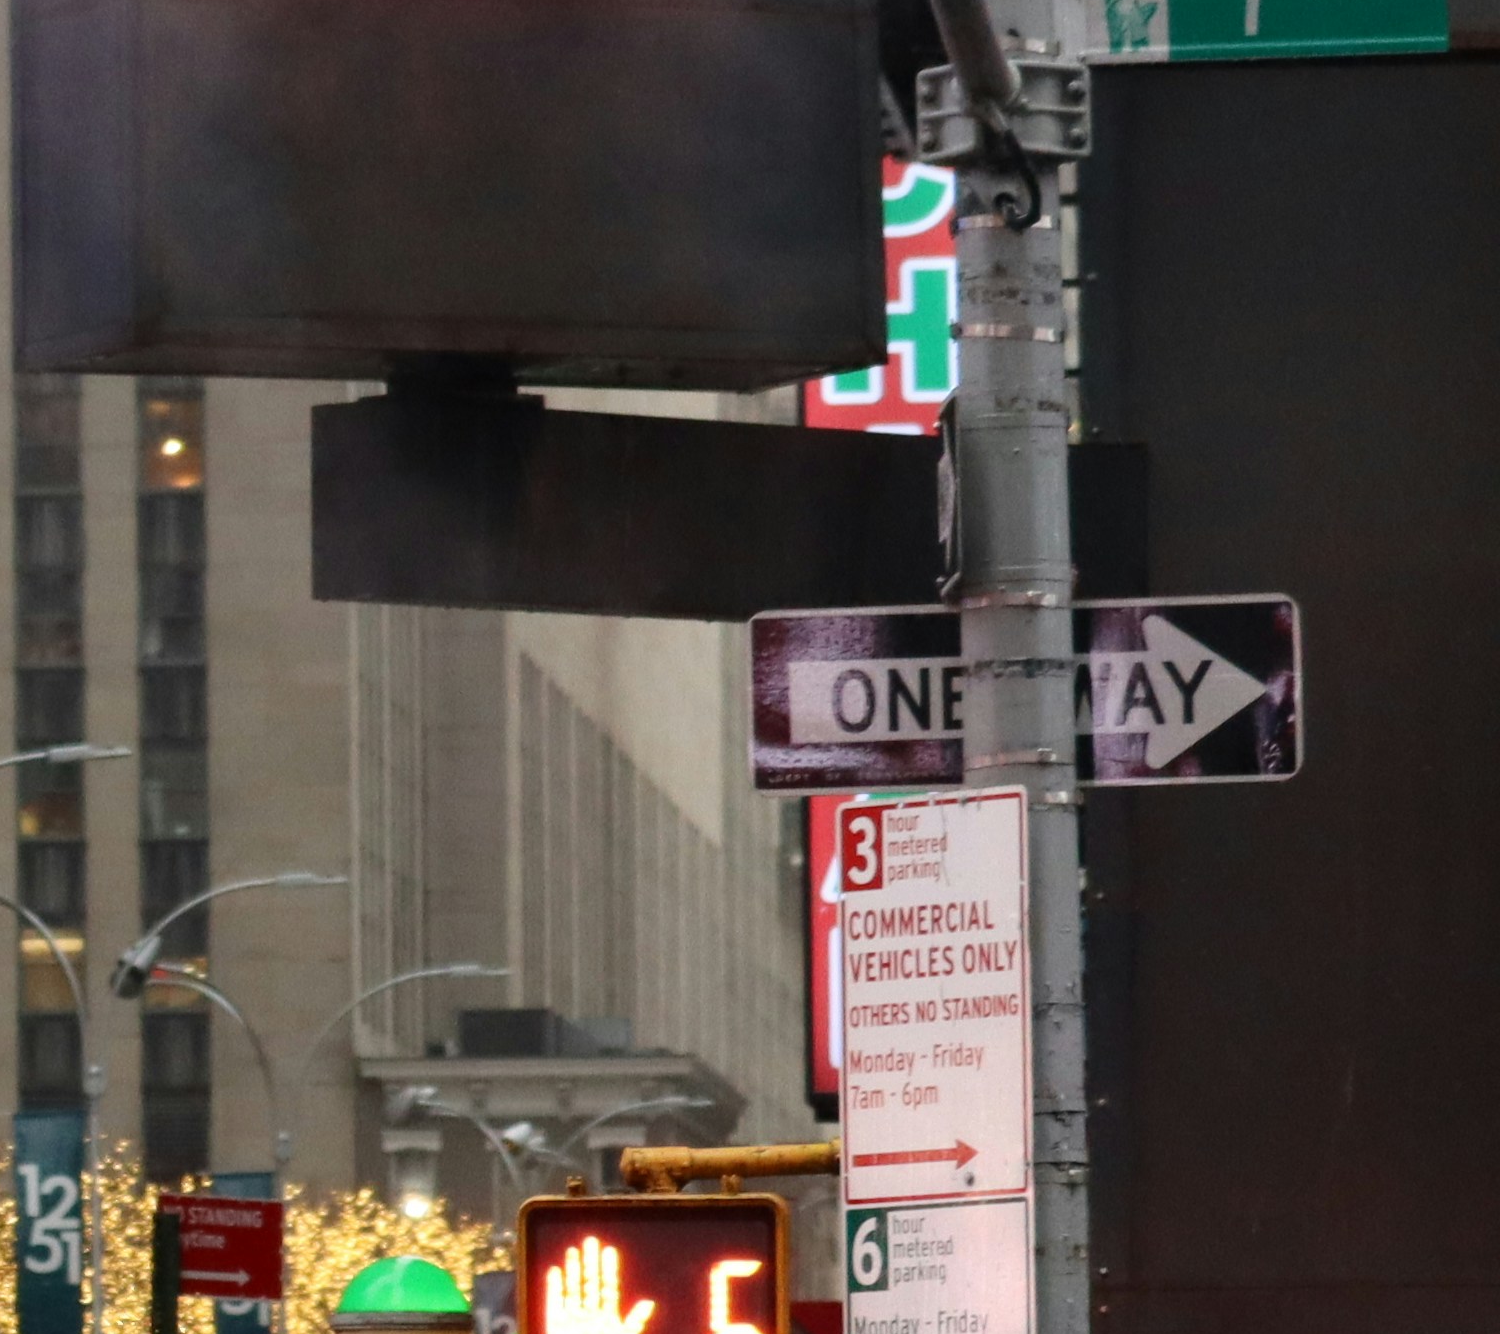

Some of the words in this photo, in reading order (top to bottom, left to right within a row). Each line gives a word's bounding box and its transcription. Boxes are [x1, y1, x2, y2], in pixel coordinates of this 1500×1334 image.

[832, 667, 963, 733] ONE
[1074, 660, 1213, 725] WAY
[887, 815, 919, 834] hour
[848, 816, 878, 885] 3
[887, 832, 948, 857] metered
[887, 858, 941, 884] parking
[850, 899, 995, 941] COMMERCIAL
[850, 946, 955, 982] VEHICLES
[963, 940, 1019, 975] ONLY
[850, 1002, 910, 1028] OTHERS
[916, 1000, 937, 1024] NO
[943, 993, 1019, 1021] STANDING
[850, 1047, 916, 1076] Monday
[933, 1043, 985, 1071] Friday
[851, 1086, 885, 1110] 7am
[902, 1083, 939, 1111] 6pm
[17, 1164, 78, 1220] 12
[893, 1215, 925, 1234] hour
[24, 1217, 82, 1285] 51
[853, 1216, 884, 1286] 6
[893, 1235, 954, 1259] metered
[893, 1263, 947, 1285] parking
